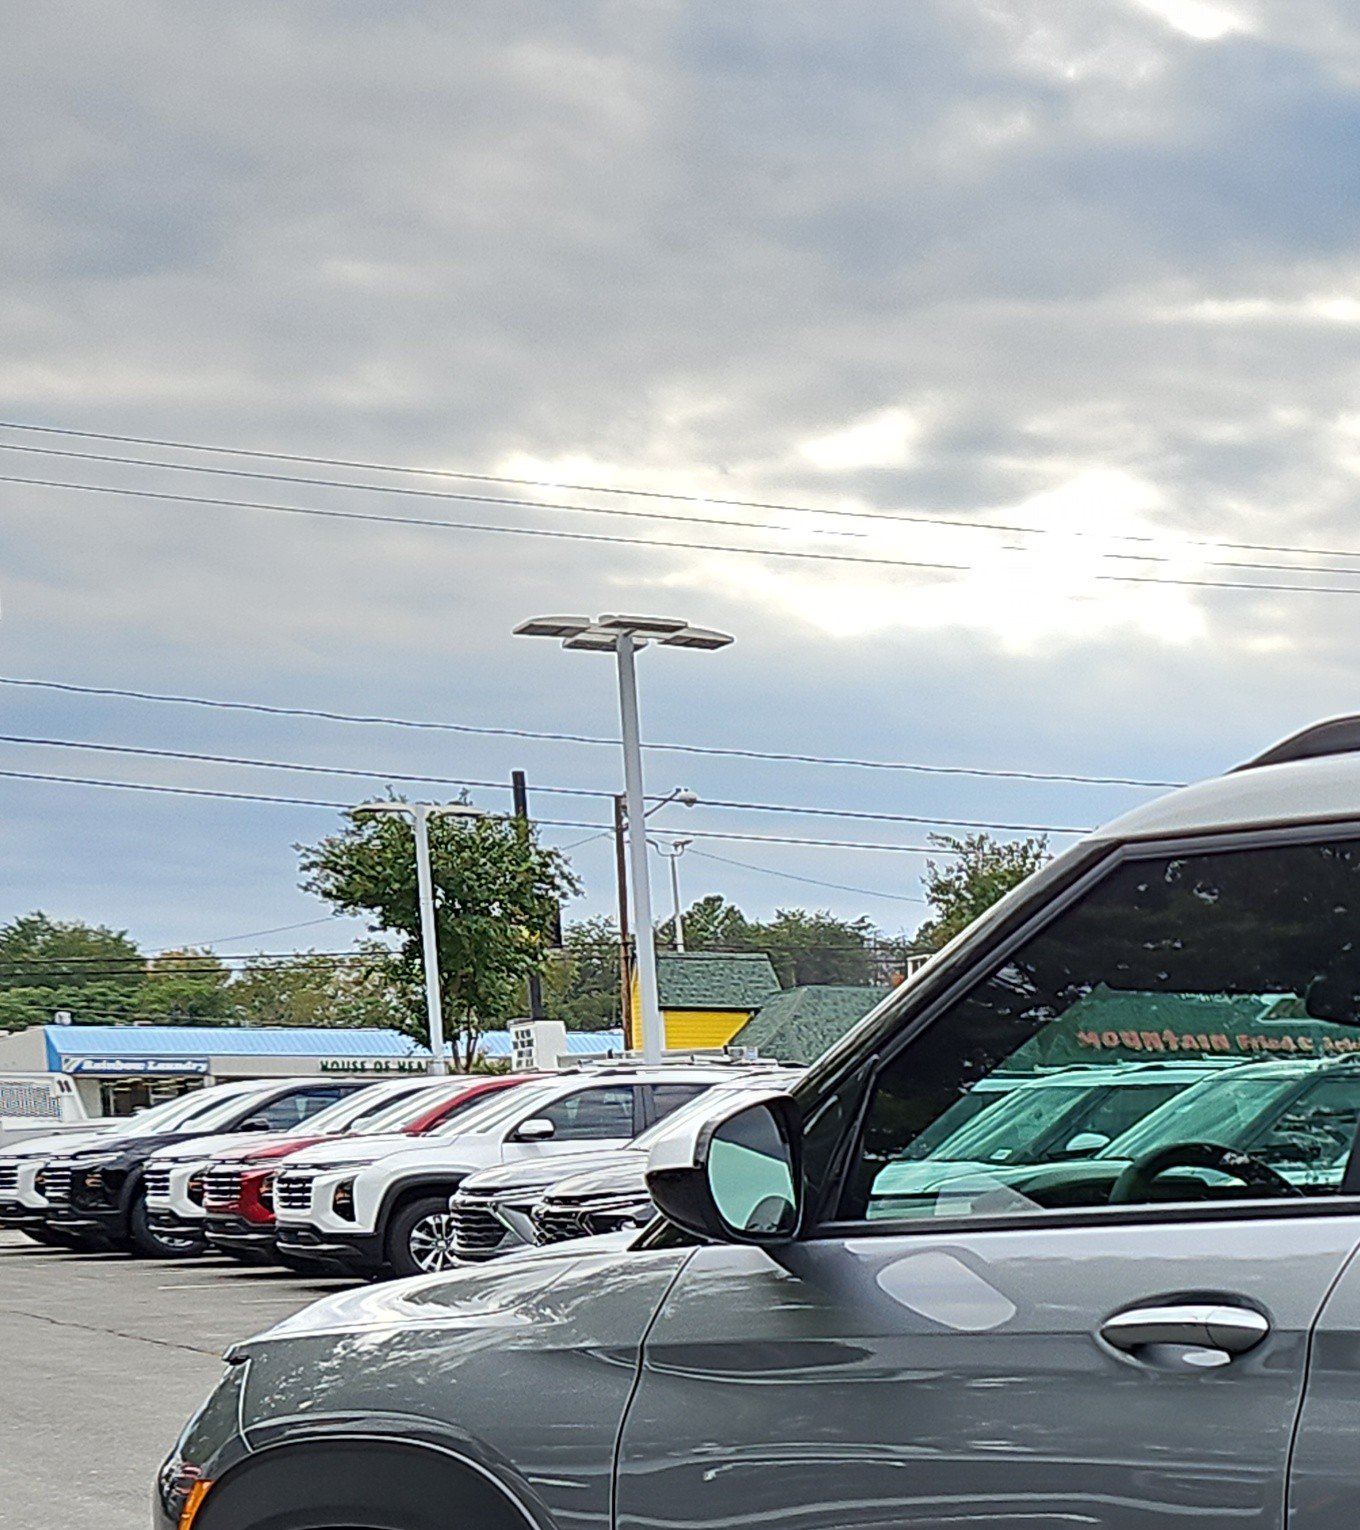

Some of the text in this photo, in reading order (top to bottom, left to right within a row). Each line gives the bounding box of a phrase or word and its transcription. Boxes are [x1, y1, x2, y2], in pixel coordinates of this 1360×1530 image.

[147, 1059, 209, 1073] Laundry
[320, 1060, 367, 1073] HOUSE
[374, 1060, 390, 1073] OF
